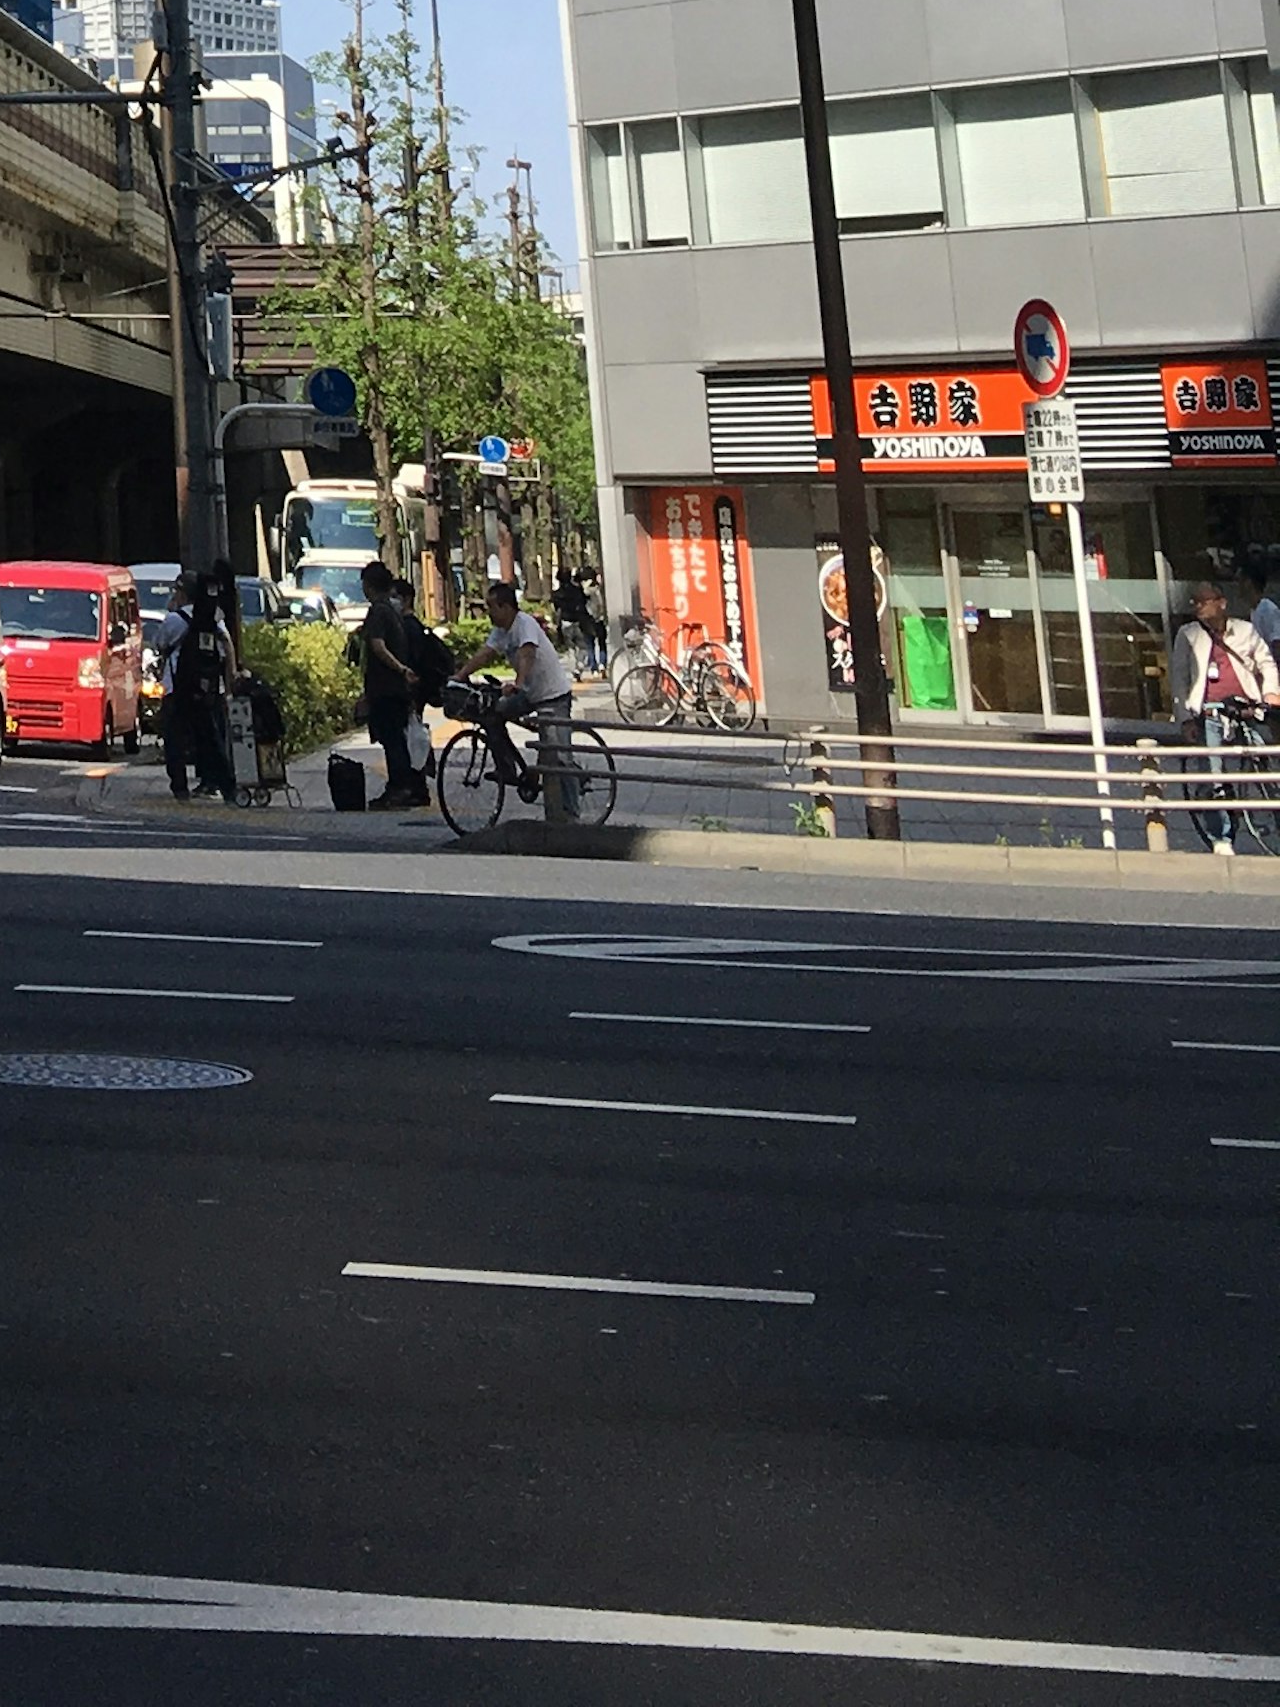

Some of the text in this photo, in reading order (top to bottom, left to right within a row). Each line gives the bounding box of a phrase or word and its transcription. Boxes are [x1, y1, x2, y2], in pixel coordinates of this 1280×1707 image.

[869, 377, 982, 429] 吉野家
[1174, 376, 1261, 415] 吉野家
[872, 435, 986, 459] YOSHINOYA
[1180, 433, 1266, 452] YOSHINOYA
